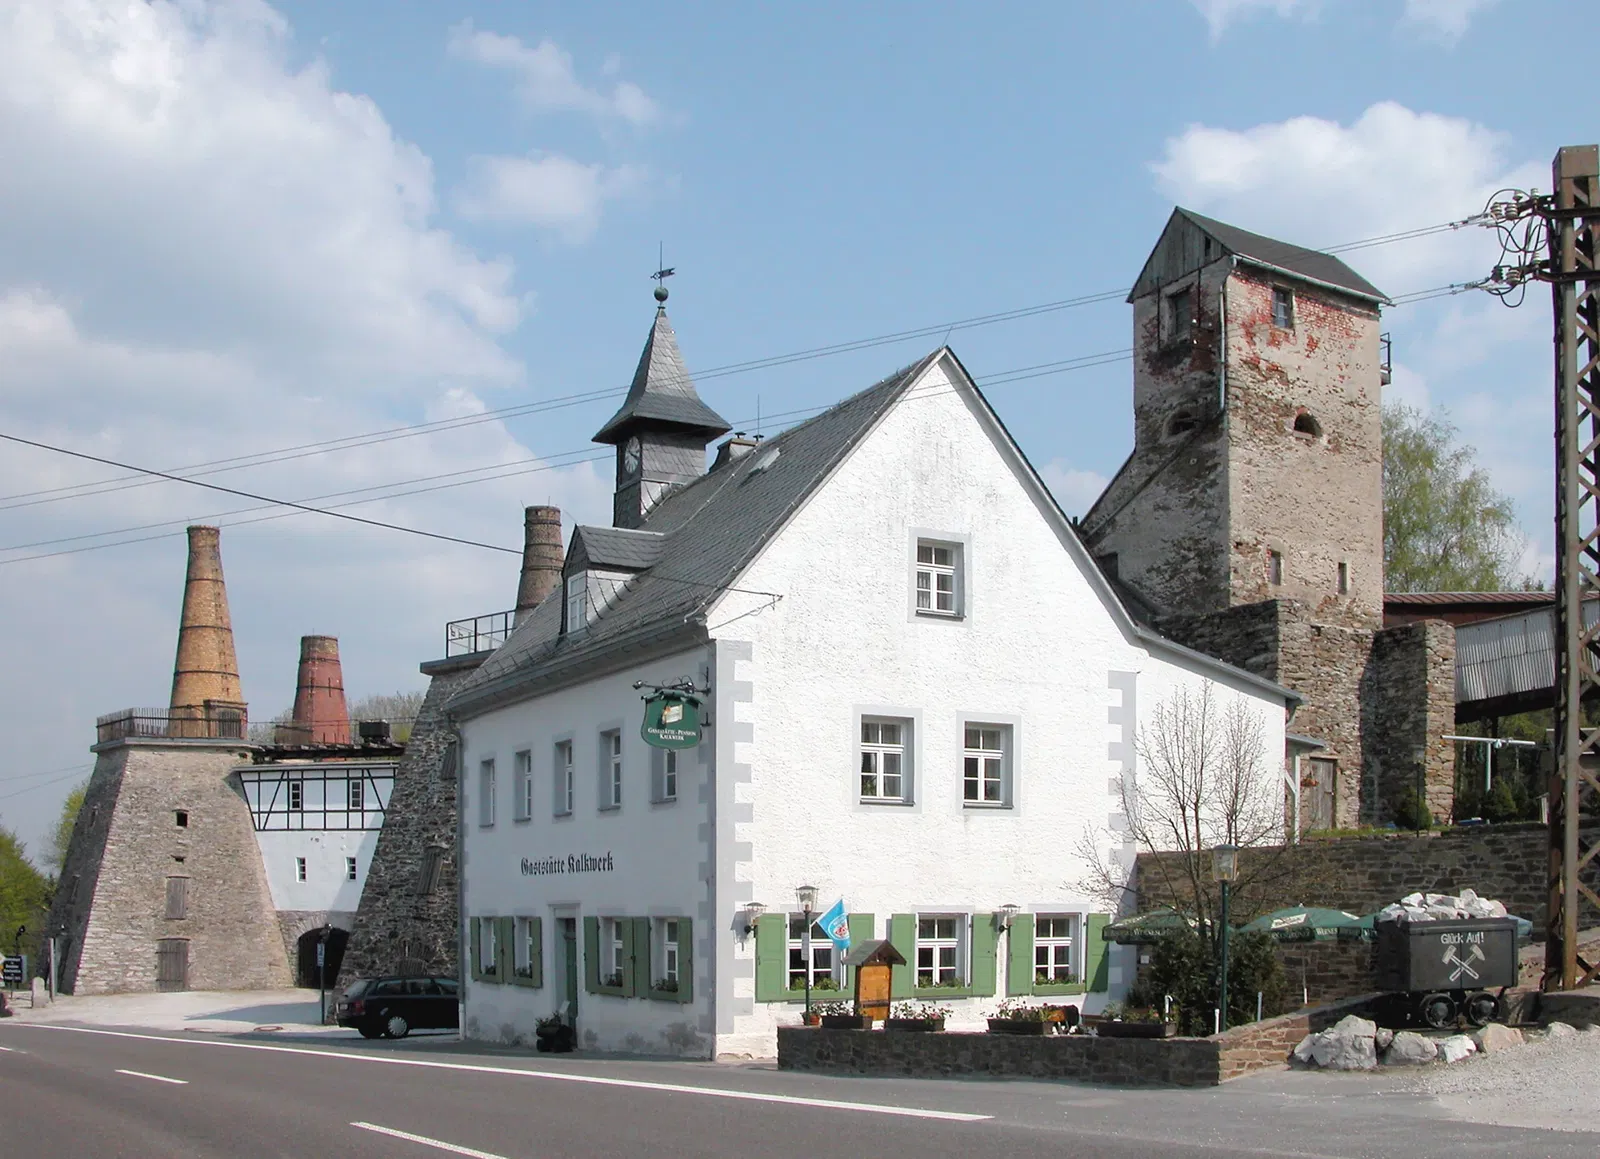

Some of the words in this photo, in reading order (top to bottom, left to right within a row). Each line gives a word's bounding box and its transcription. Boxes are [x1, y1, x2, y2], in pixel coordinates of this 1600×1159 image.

[521, 856, 565, 876] Gaststätte
[567, 851, 613, 873] Kalkwerk
[1440, 932, 1464, 944] Glück
